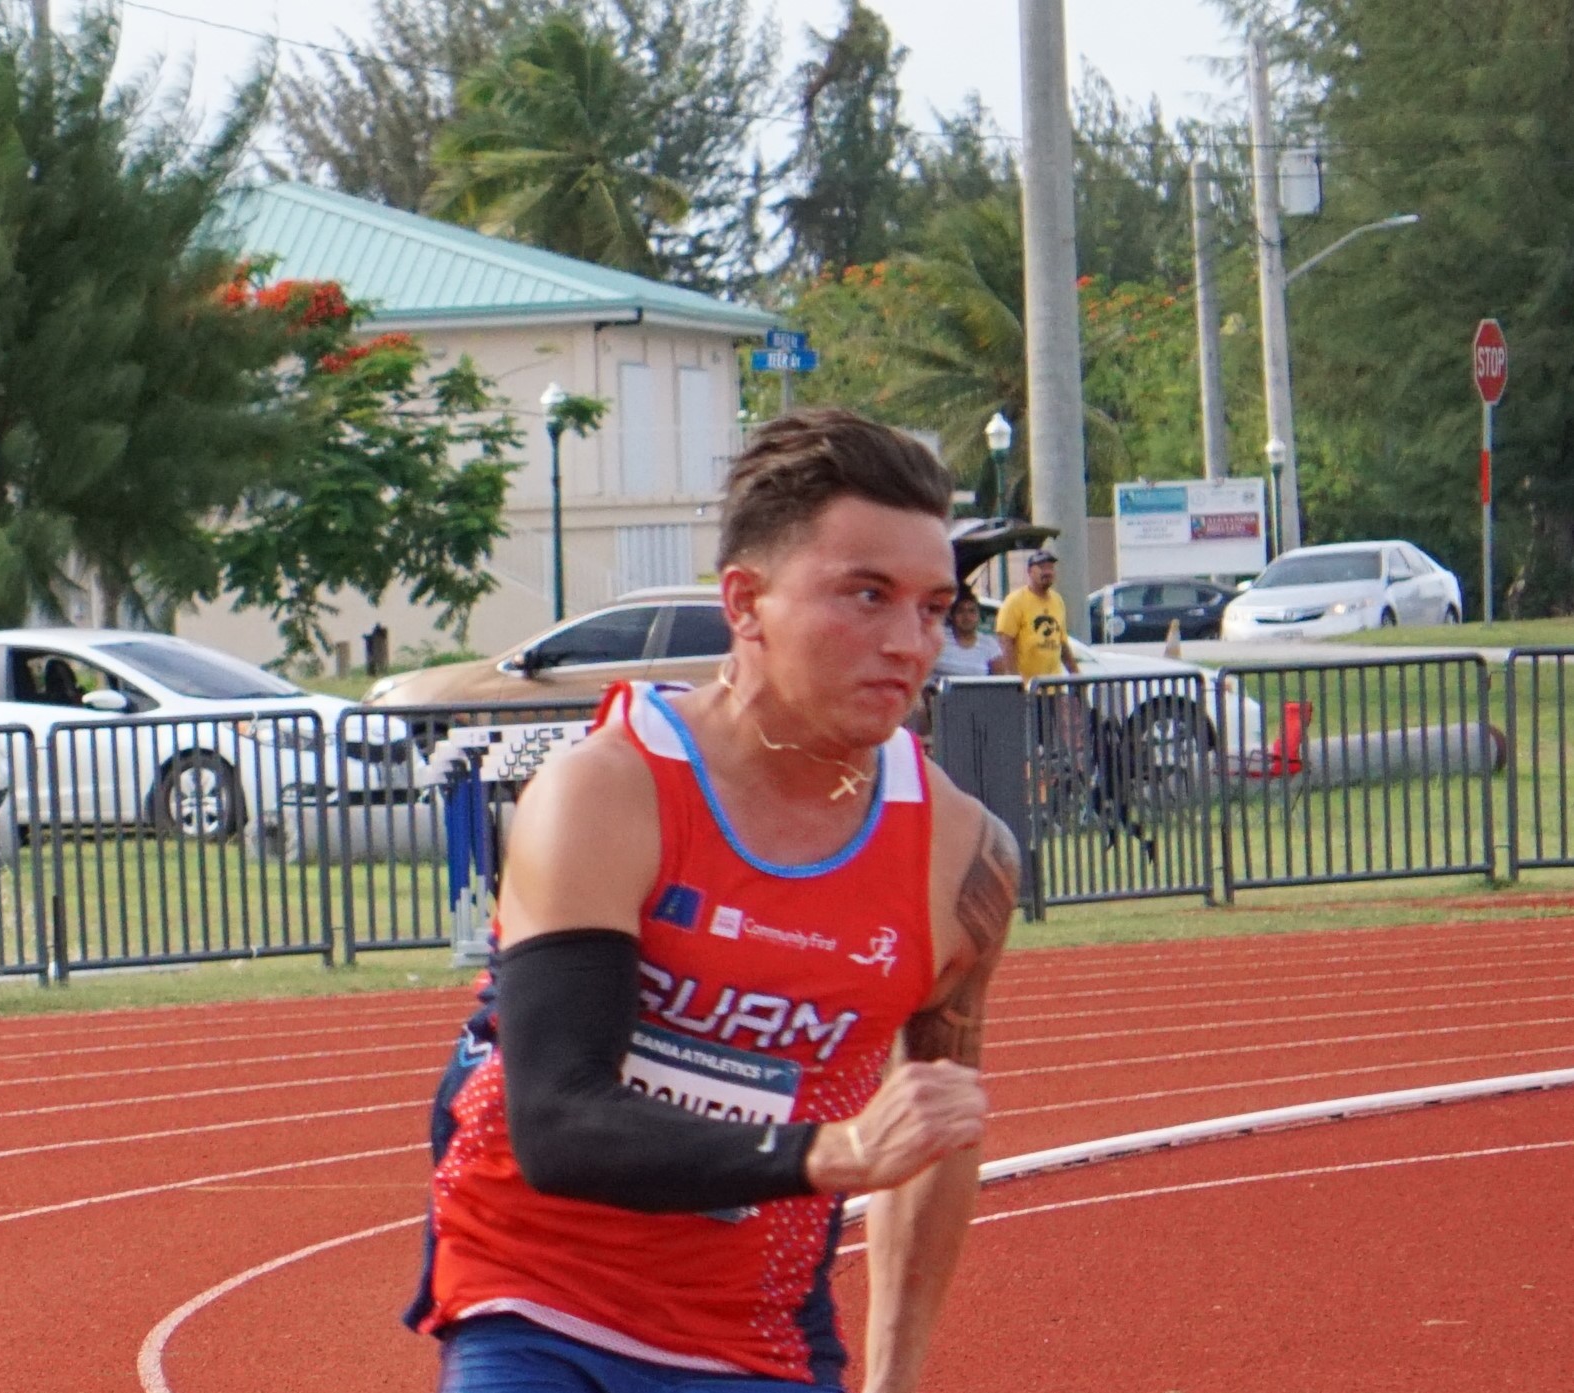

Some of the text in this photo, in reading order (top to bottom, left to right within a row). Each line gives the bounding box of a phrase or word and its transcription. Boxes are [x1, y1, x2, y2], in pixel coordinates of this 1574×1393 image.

[1478, 346, 1505, 378] STOP
[524, 728, 564, 740] UCS
[640, 961, 858, 1061] GUAM
[631, 1031, 680, 1059] EANIA
